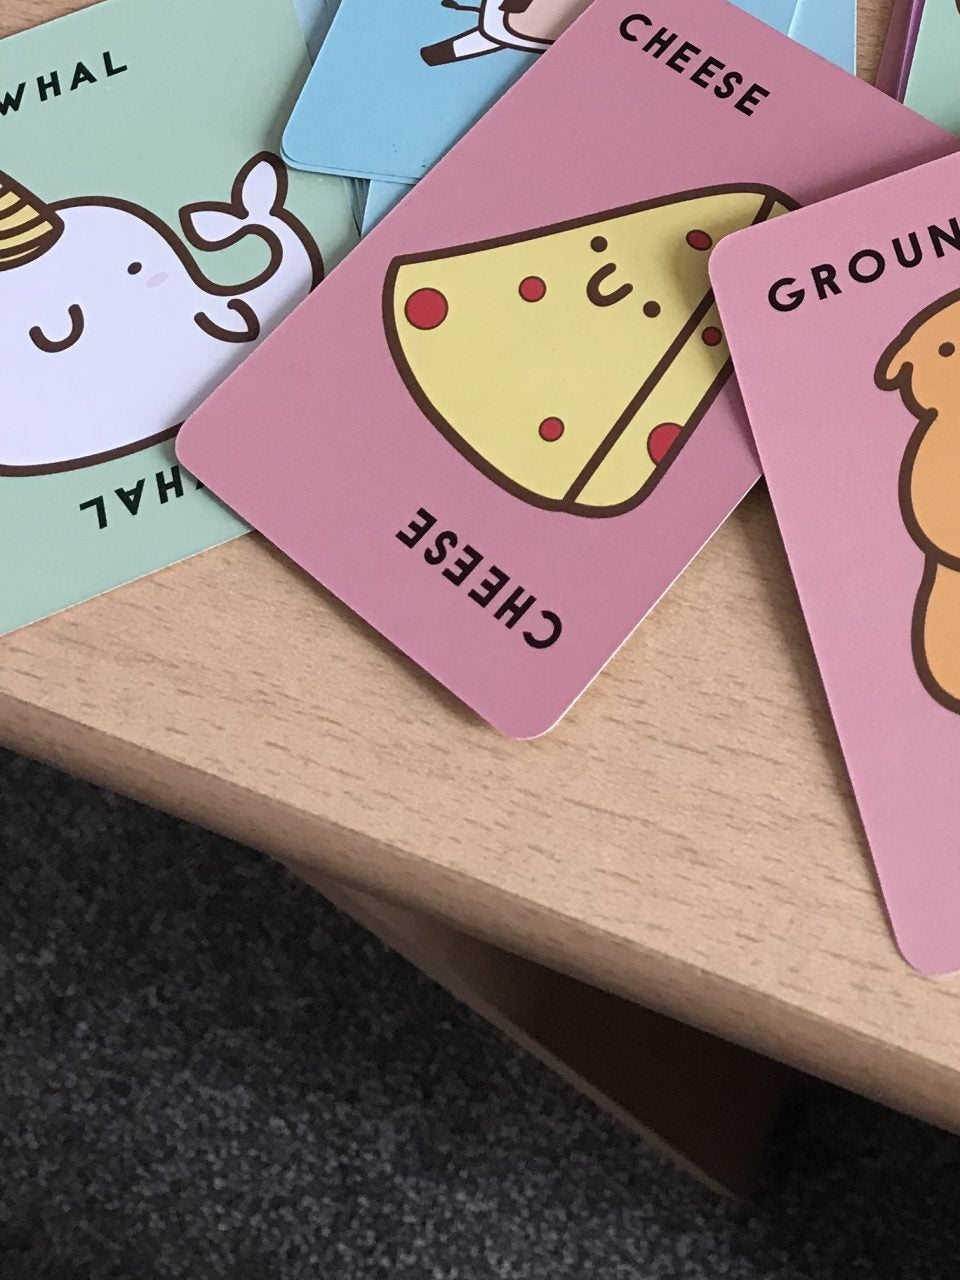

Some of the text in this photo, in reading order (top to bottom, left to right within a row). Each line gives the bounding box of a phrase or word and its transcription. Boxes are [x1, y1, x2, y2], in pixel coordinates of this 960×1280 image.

[620, 14, 770, 116] CHEESE
[79, 465, 204, 529] HAL
[396, 507, 564, 650] CHEESE
